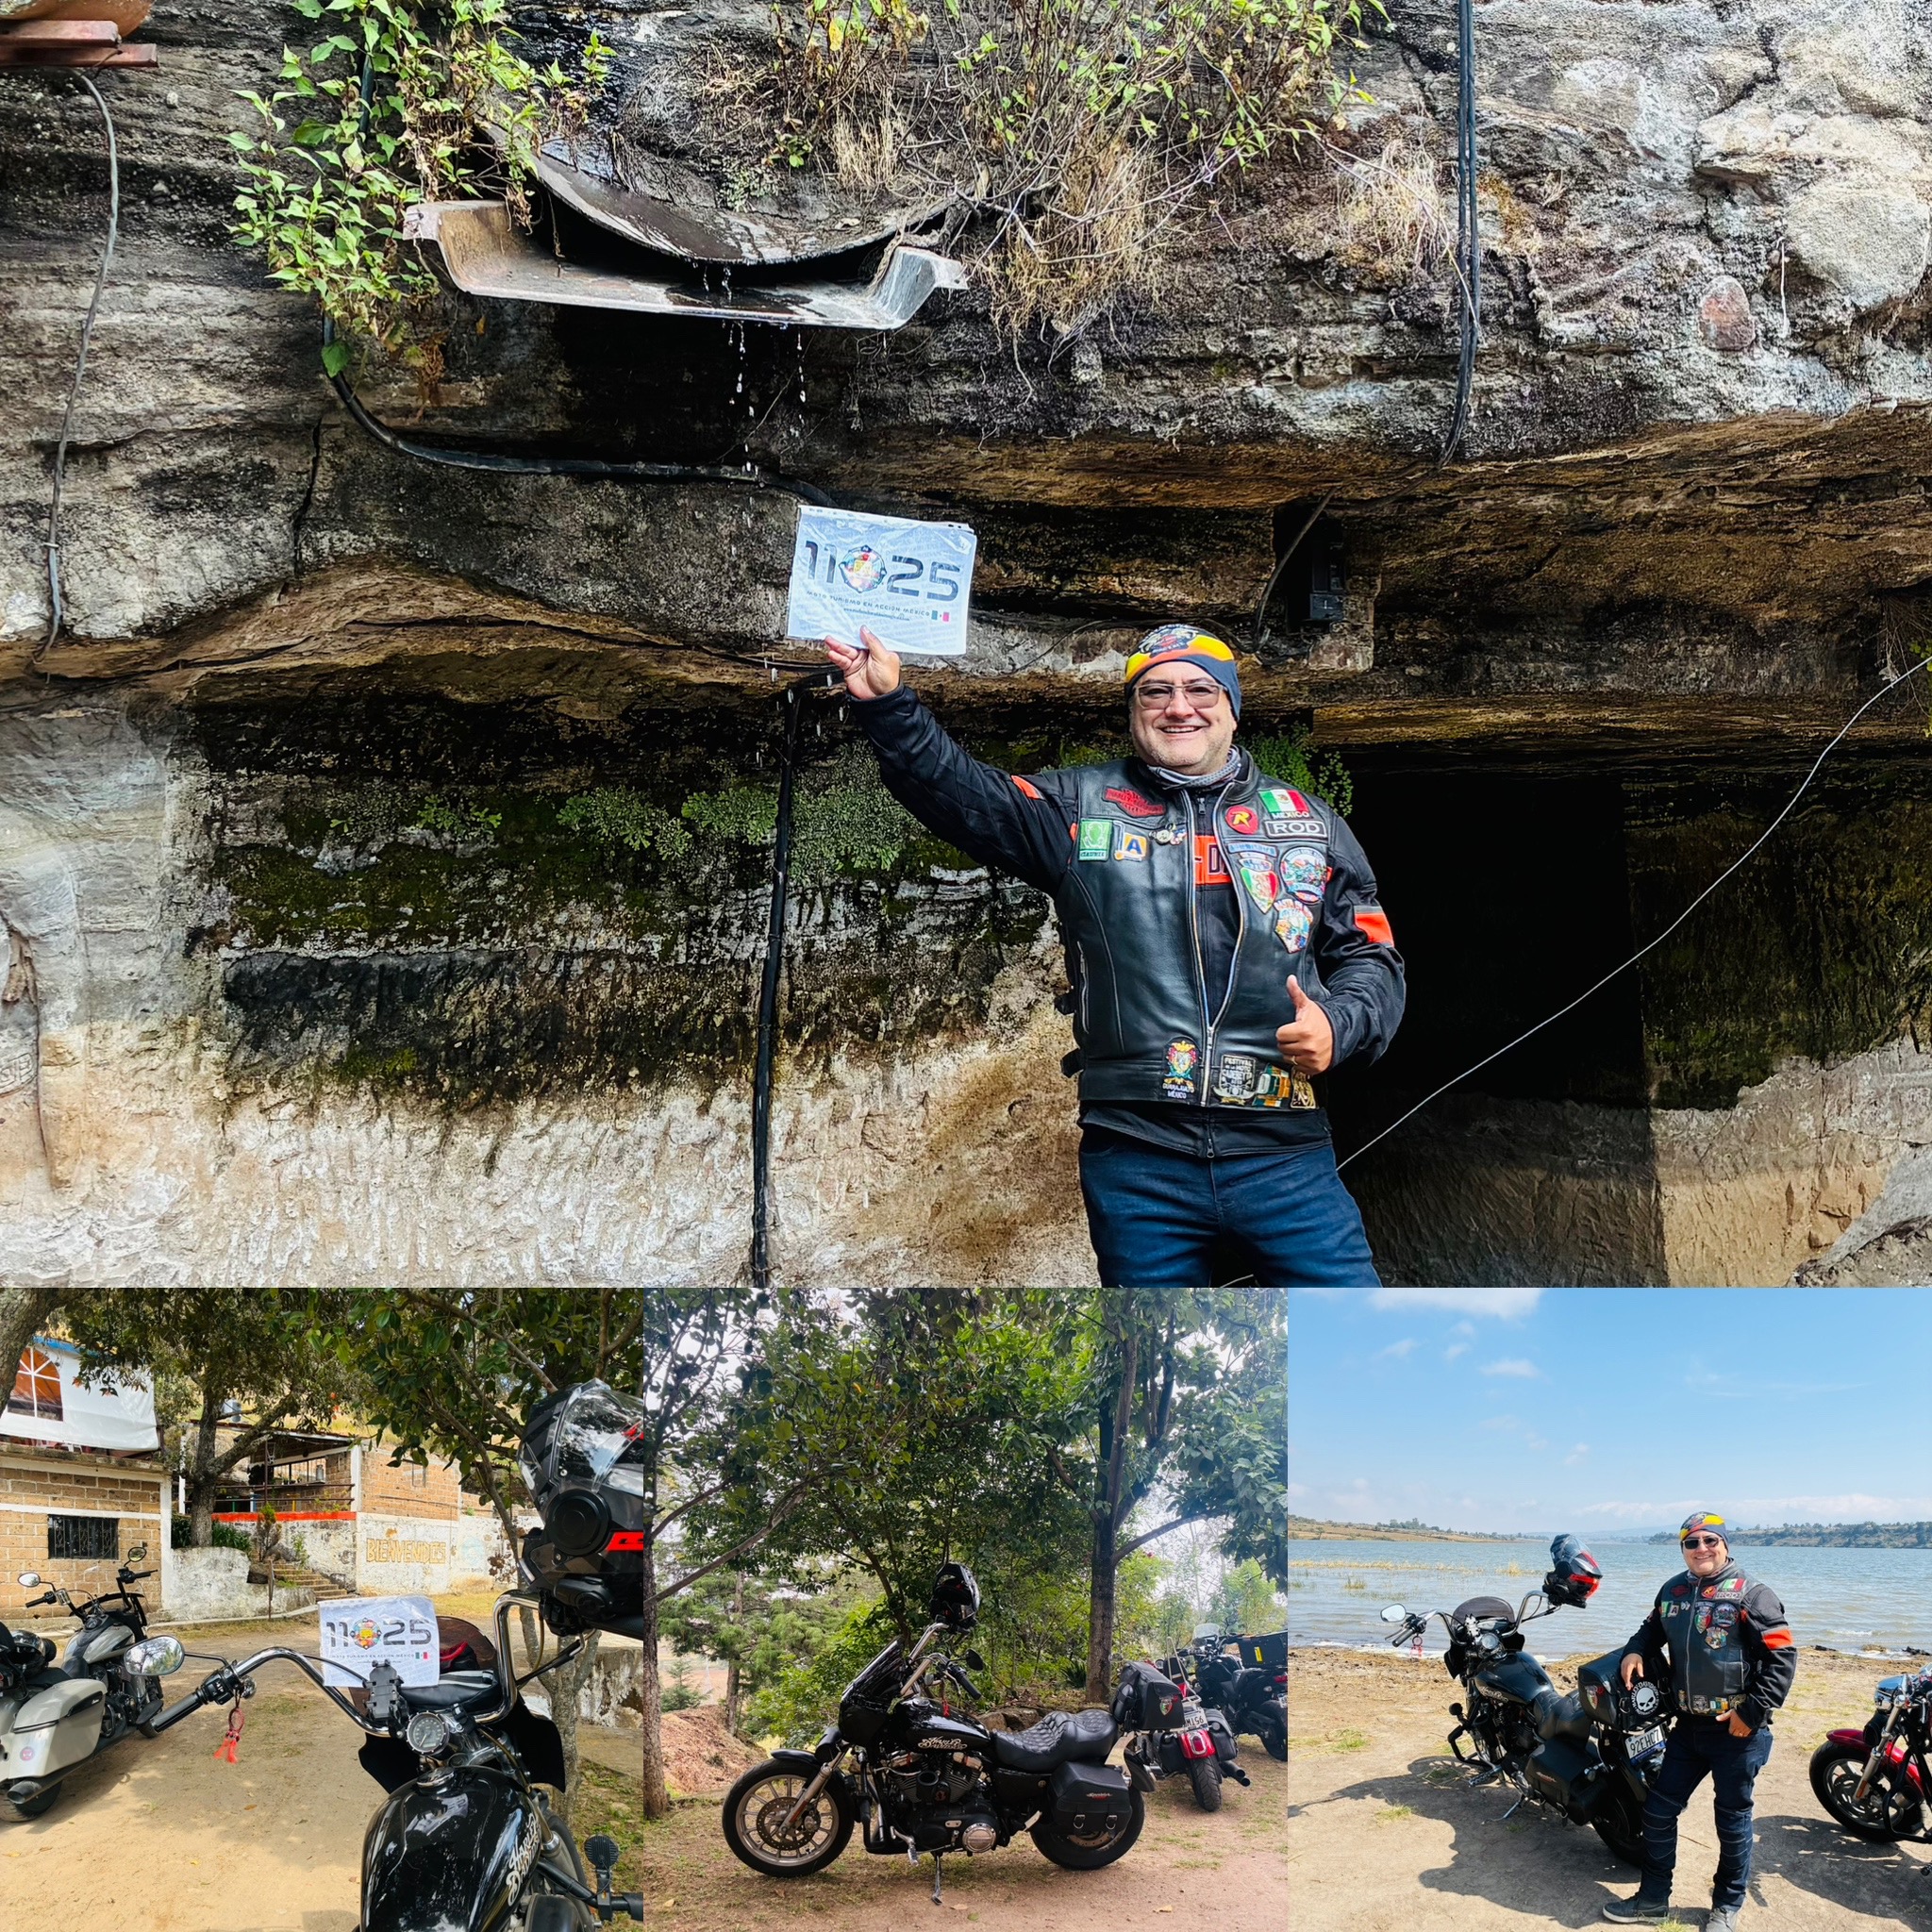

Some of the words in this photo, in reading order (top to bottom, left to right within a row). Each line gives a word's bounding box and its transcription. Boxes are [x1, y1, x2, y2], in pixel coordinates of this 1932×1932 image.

[829, 595, 861, 606] TURISMO
[1274, 823, 1320, 836] ROD
[1125, 839, 1142, 855] A
[1224, 1057, 1253, 1067] FESTIVAL
[366, 1538, 446, 1564] BIENVENIDOS
